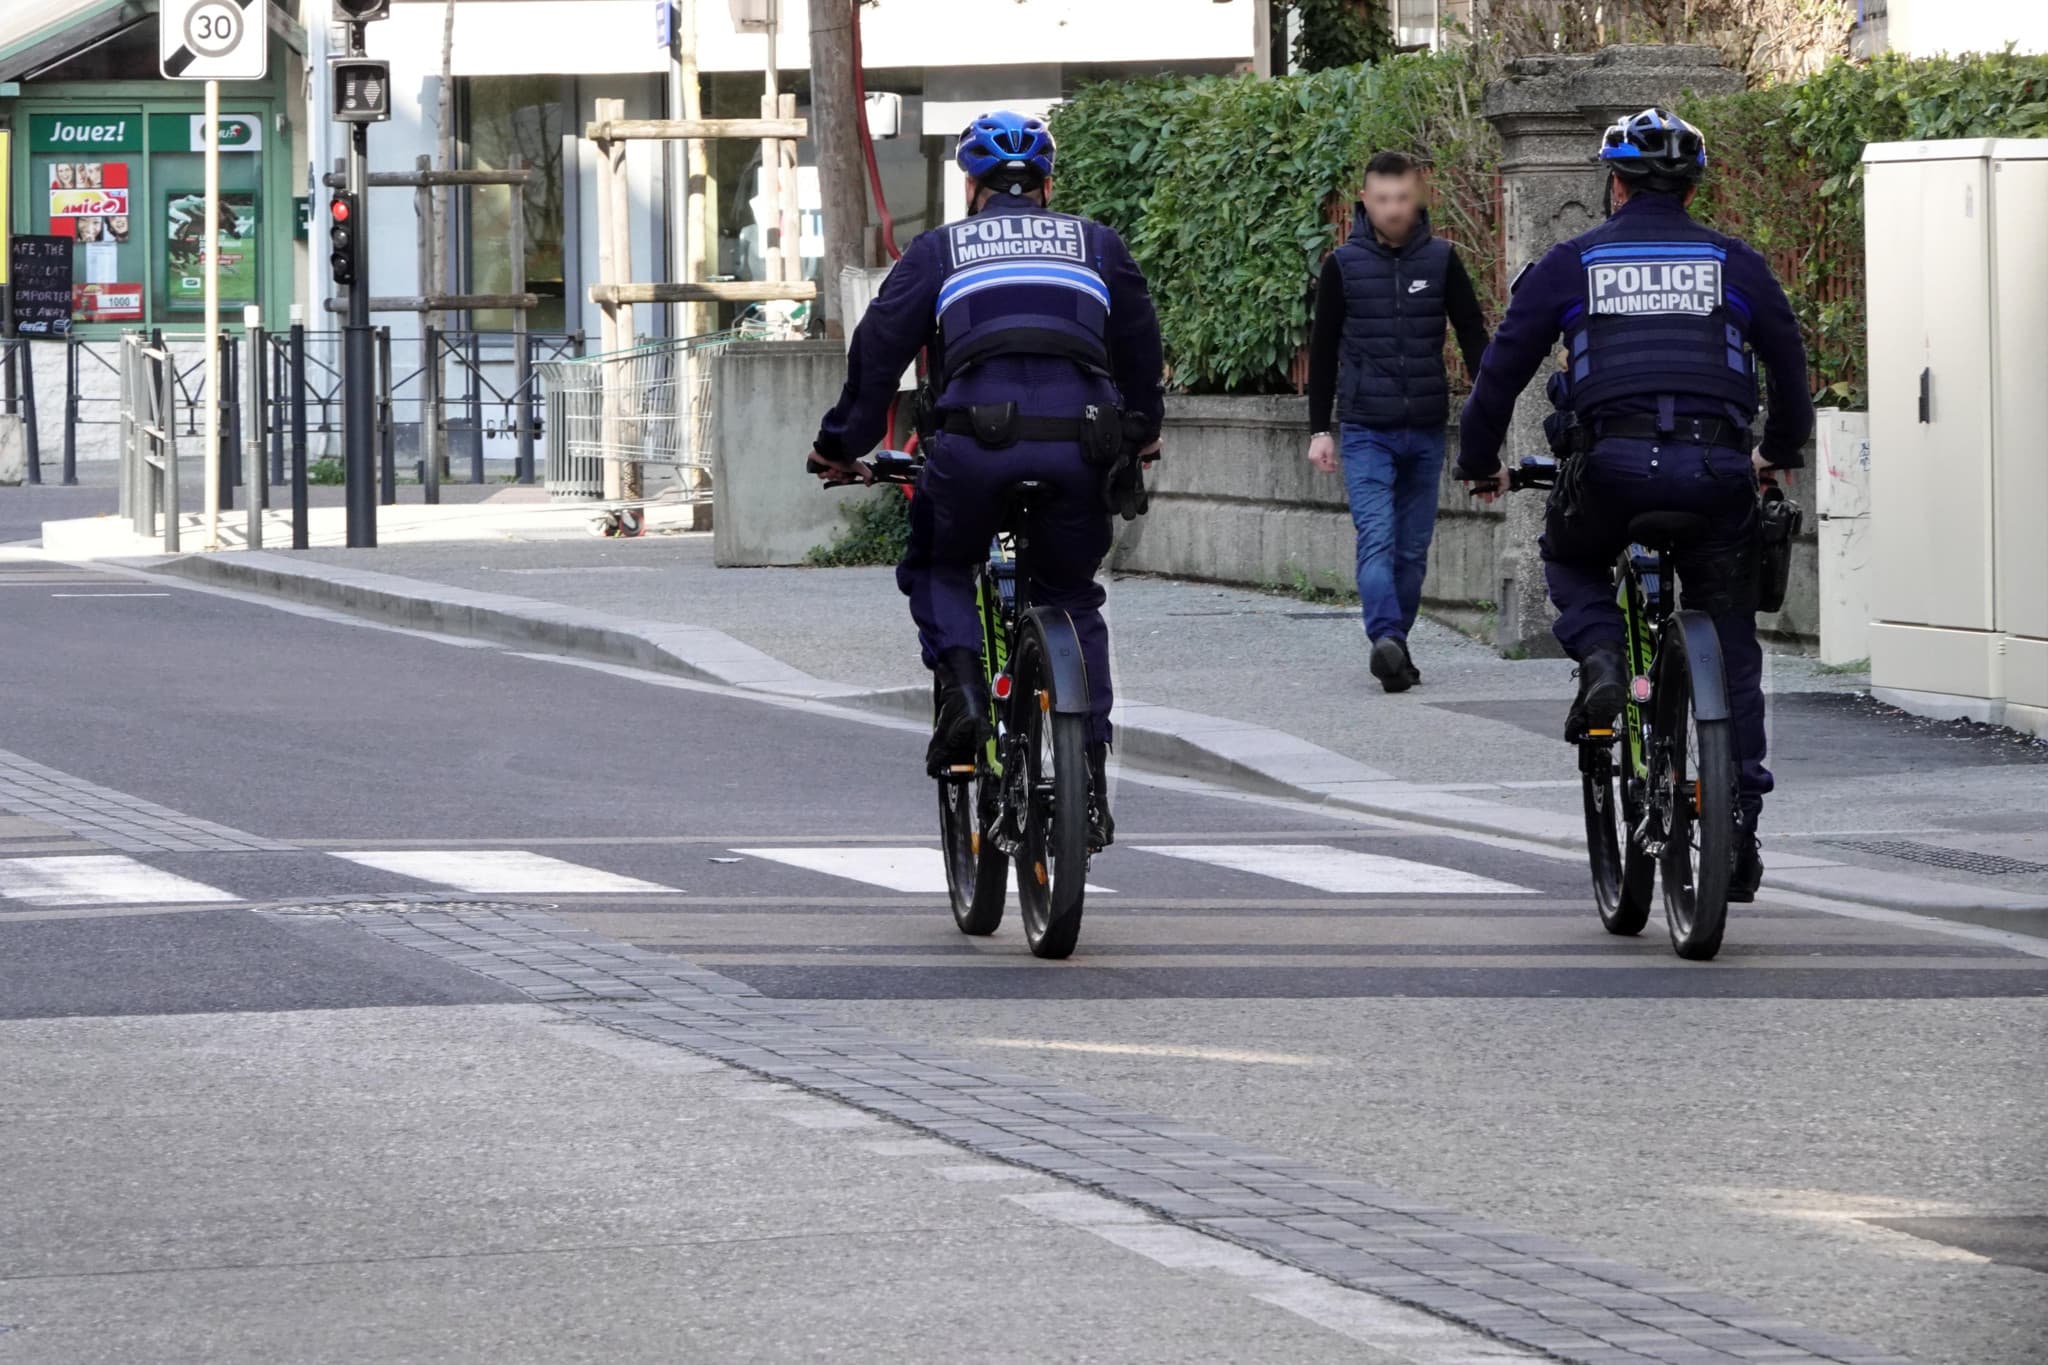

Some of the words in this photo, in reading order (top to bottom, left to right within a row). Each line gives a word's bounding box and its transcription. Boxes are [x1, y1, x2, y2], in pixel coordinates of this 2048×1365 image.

[198, 15, 231, 39] 30
[49, 121, 126, 142] Jouez!
[956, 218, 1077, 245] POLICE
[958, 239, 1079, 263] MUNICIPALE
[1595, 264, 1715, 297] POLICE
[1597, 292, 1715, 315] MUNICIPALE
